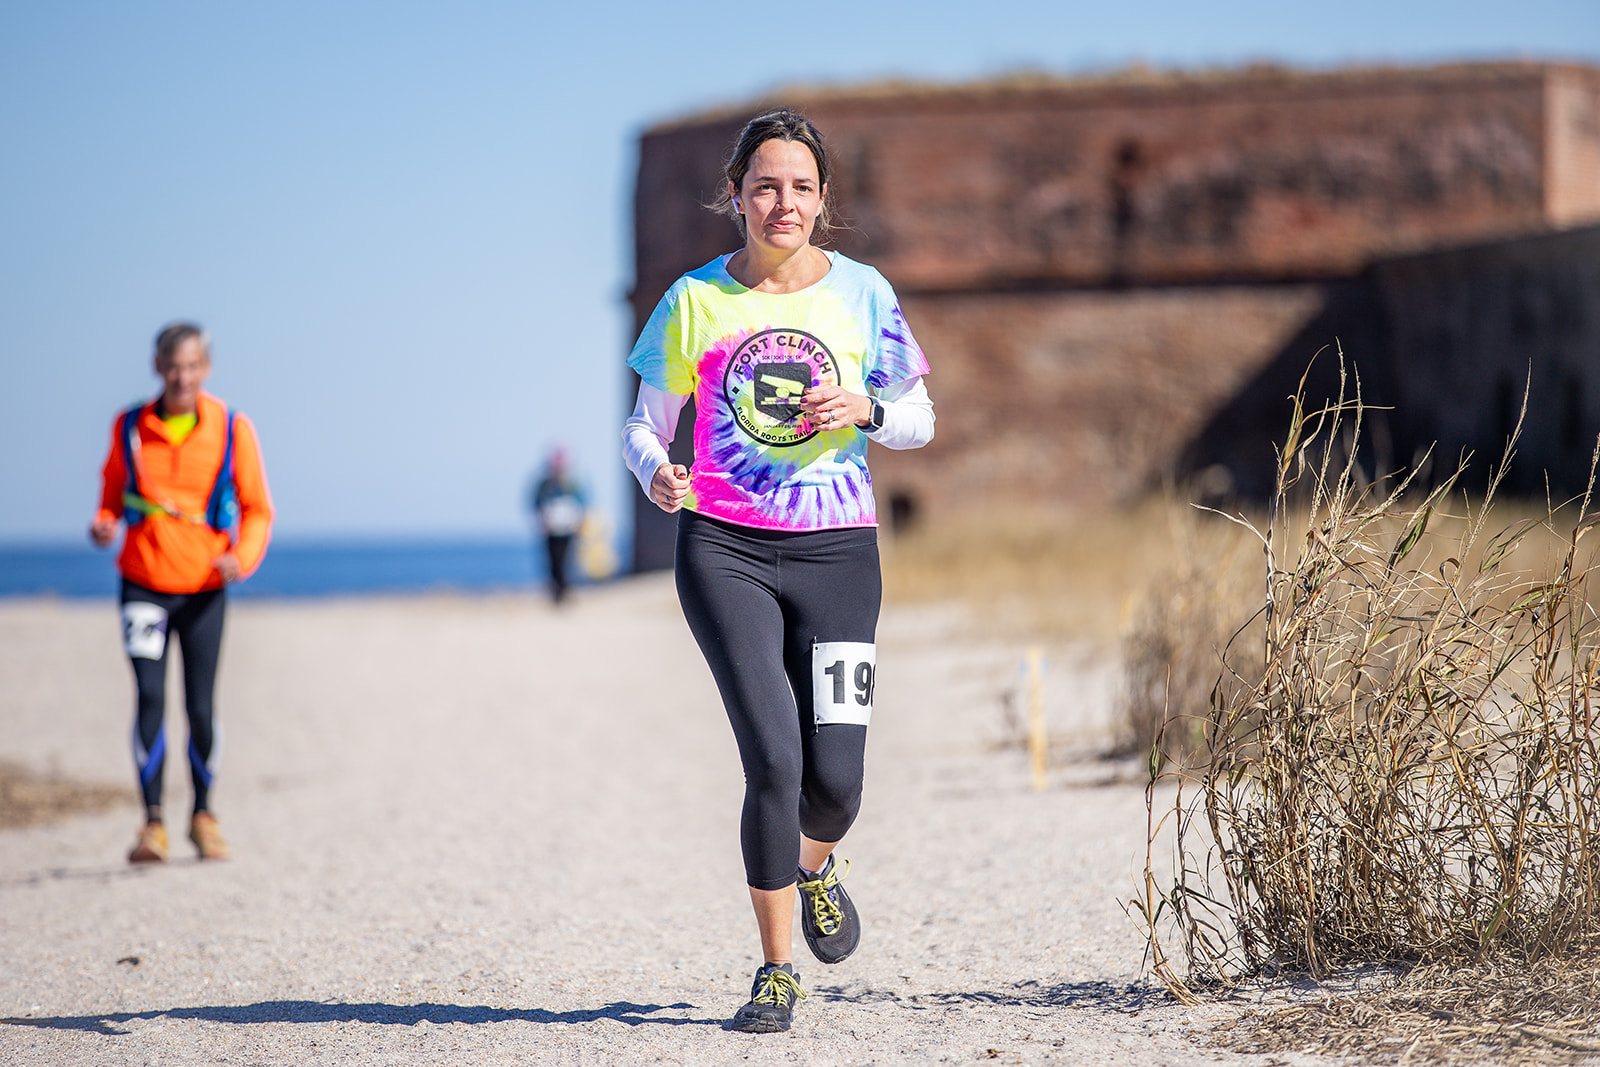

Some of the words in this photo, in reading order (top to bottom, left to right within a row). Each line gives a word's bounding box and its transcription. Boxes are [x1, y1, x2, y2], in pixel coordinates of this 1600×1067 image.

[733, 338, 769, 376] FORT
[776, 335, 832, 375] CLINCH
[737, 406, 759, 435] FLORIDA
[760, 432, 787, 442] ROOTS
[788, 429, 811, 441] TRAIL
[824, 660, 876, 707] 19
